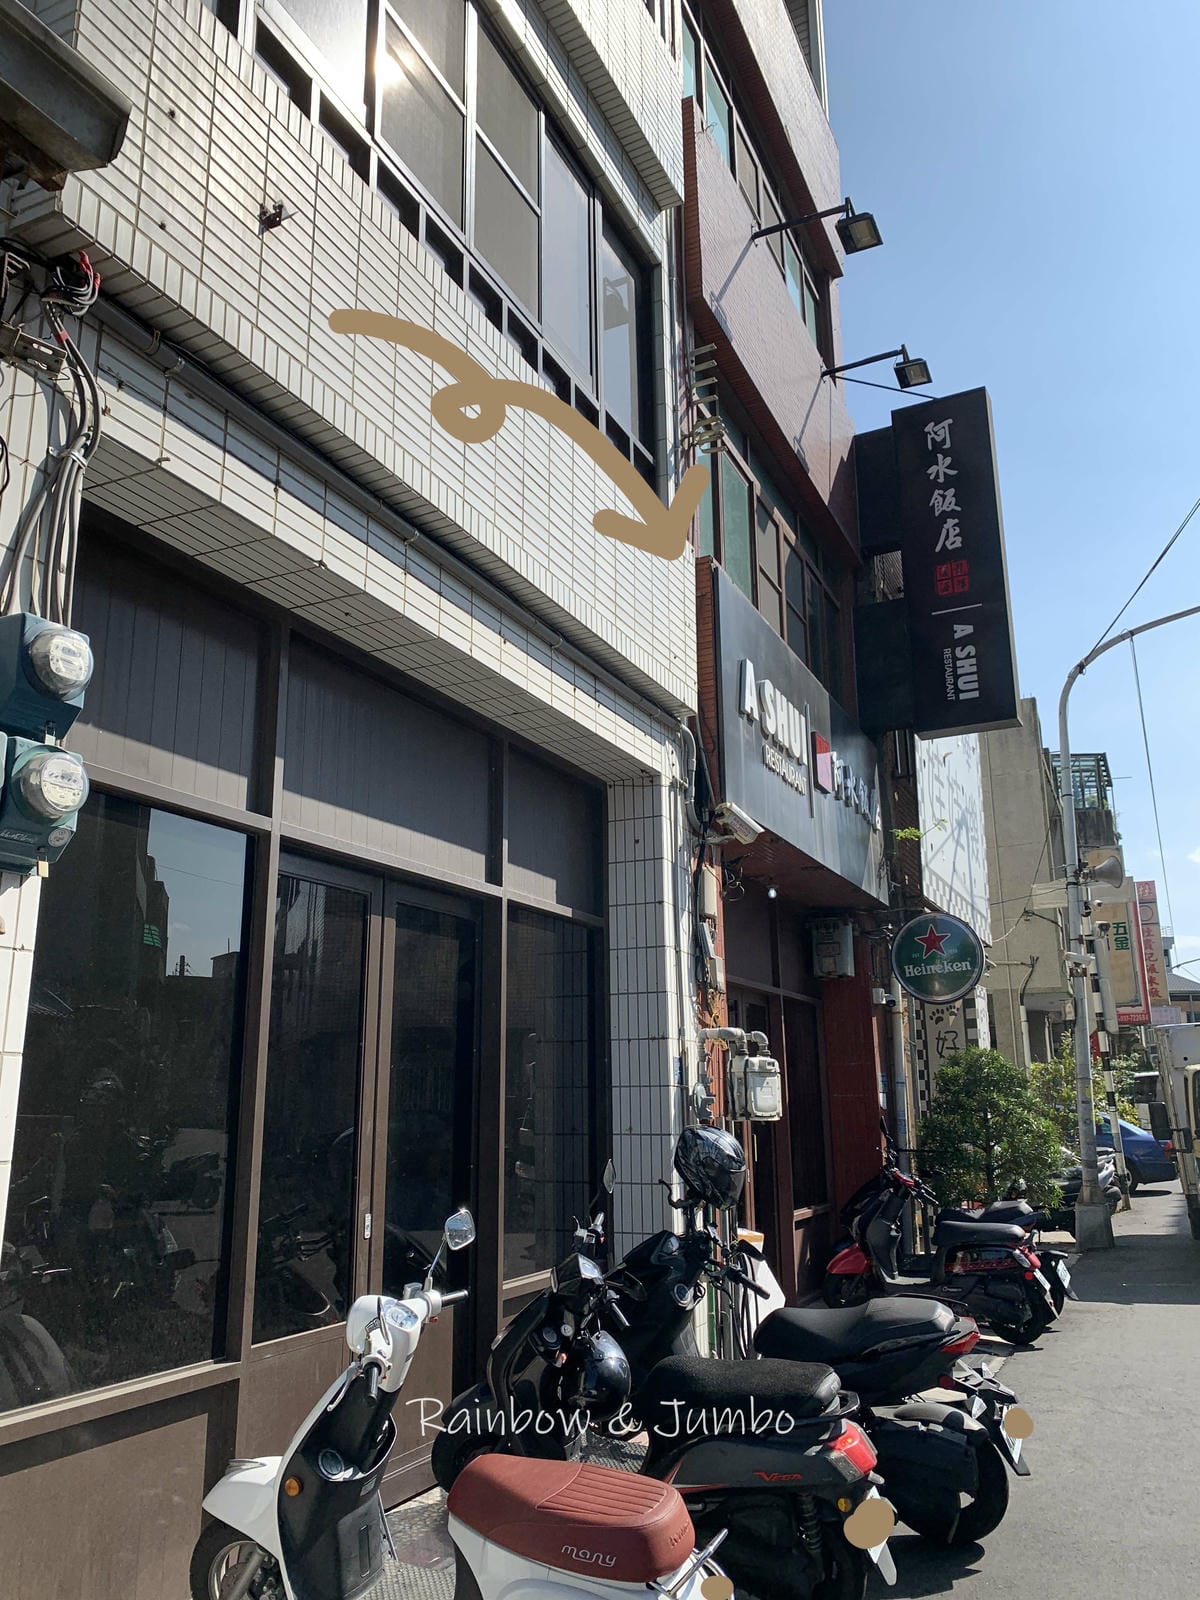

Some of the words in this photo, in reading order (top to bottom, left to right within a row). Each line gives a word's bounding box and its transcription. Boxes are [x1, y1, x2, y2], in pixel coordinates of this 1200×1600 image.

[924, 418, 962, 552] 阿水飯店
[953, 624, 974, 640] A
[943, 647, 956, 700] RESTAURANT
[955, 644, 980, 700] SHUI
[740, 658, 760, 722] A
[759, 679, 808, 767] SHUI
[763, 743, 807, 796] RESTAURANT
[1112, 921, 1130, 951] 五金
[904, 959, 972, 977] Heineken
[561, 1544, 617, 1568] many
